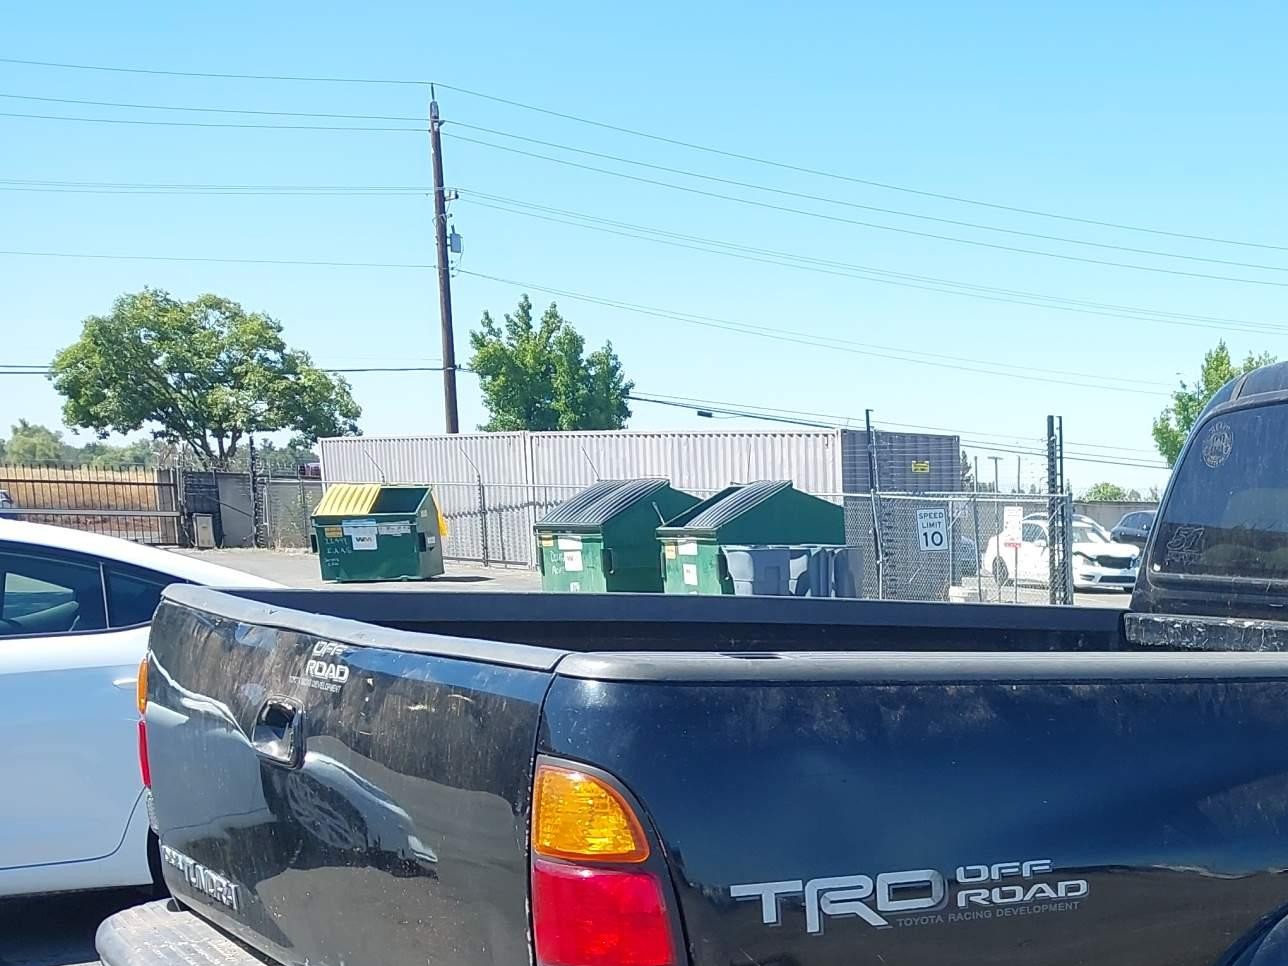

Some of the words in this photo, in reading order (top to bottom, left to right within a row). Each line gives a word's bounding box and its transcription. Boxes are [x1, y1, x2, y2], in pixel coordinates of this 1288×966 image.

[921, 521, 942, 529] LIMIT
[922, 531, 944, 547] 10
[312, 641, 348, 656] OFF
[305, 660, 350, 684] ROAD
[182, 855, 239, 911] TUNDRA
[955, 859, 1054, 885] OFF
[729, 868, 948, 935] TRD
[956, 879, 1090, 908] ROAD
[896, 915, 944, 928] TOYOTA
[948, 909, 993, 923] RACING
[996, 901, 1081, 918] DEVELOPMENT
